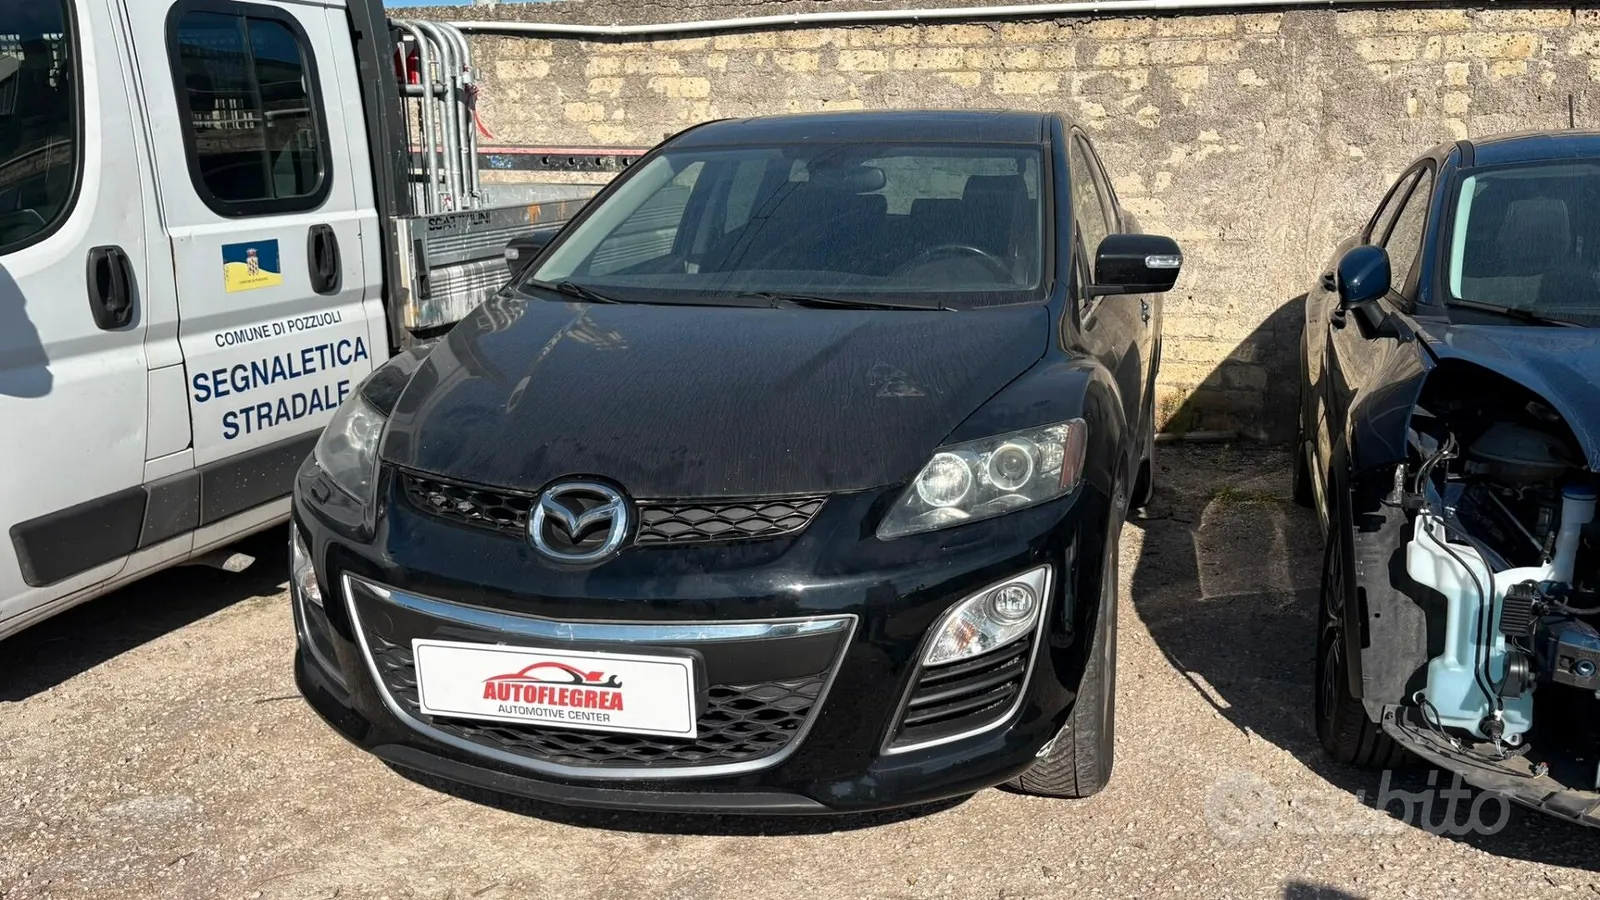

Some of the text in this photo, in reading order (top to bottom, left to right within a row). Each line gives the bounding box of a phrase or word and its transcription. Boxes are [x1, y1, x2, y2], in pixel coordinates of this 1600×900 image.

[428, 212, 492, 231] SCATLINI
[215, 311, 342, 348] COMUNE DI POZZUOLI
[193, 336, 369, 403] SEGNALETICA
[222, 379, 351, 440] STRADALE
[483, 682, 623, 711] AUTOFLEGREA
[498, 704, 610, 722] AUTOMOTIVE CENTER
